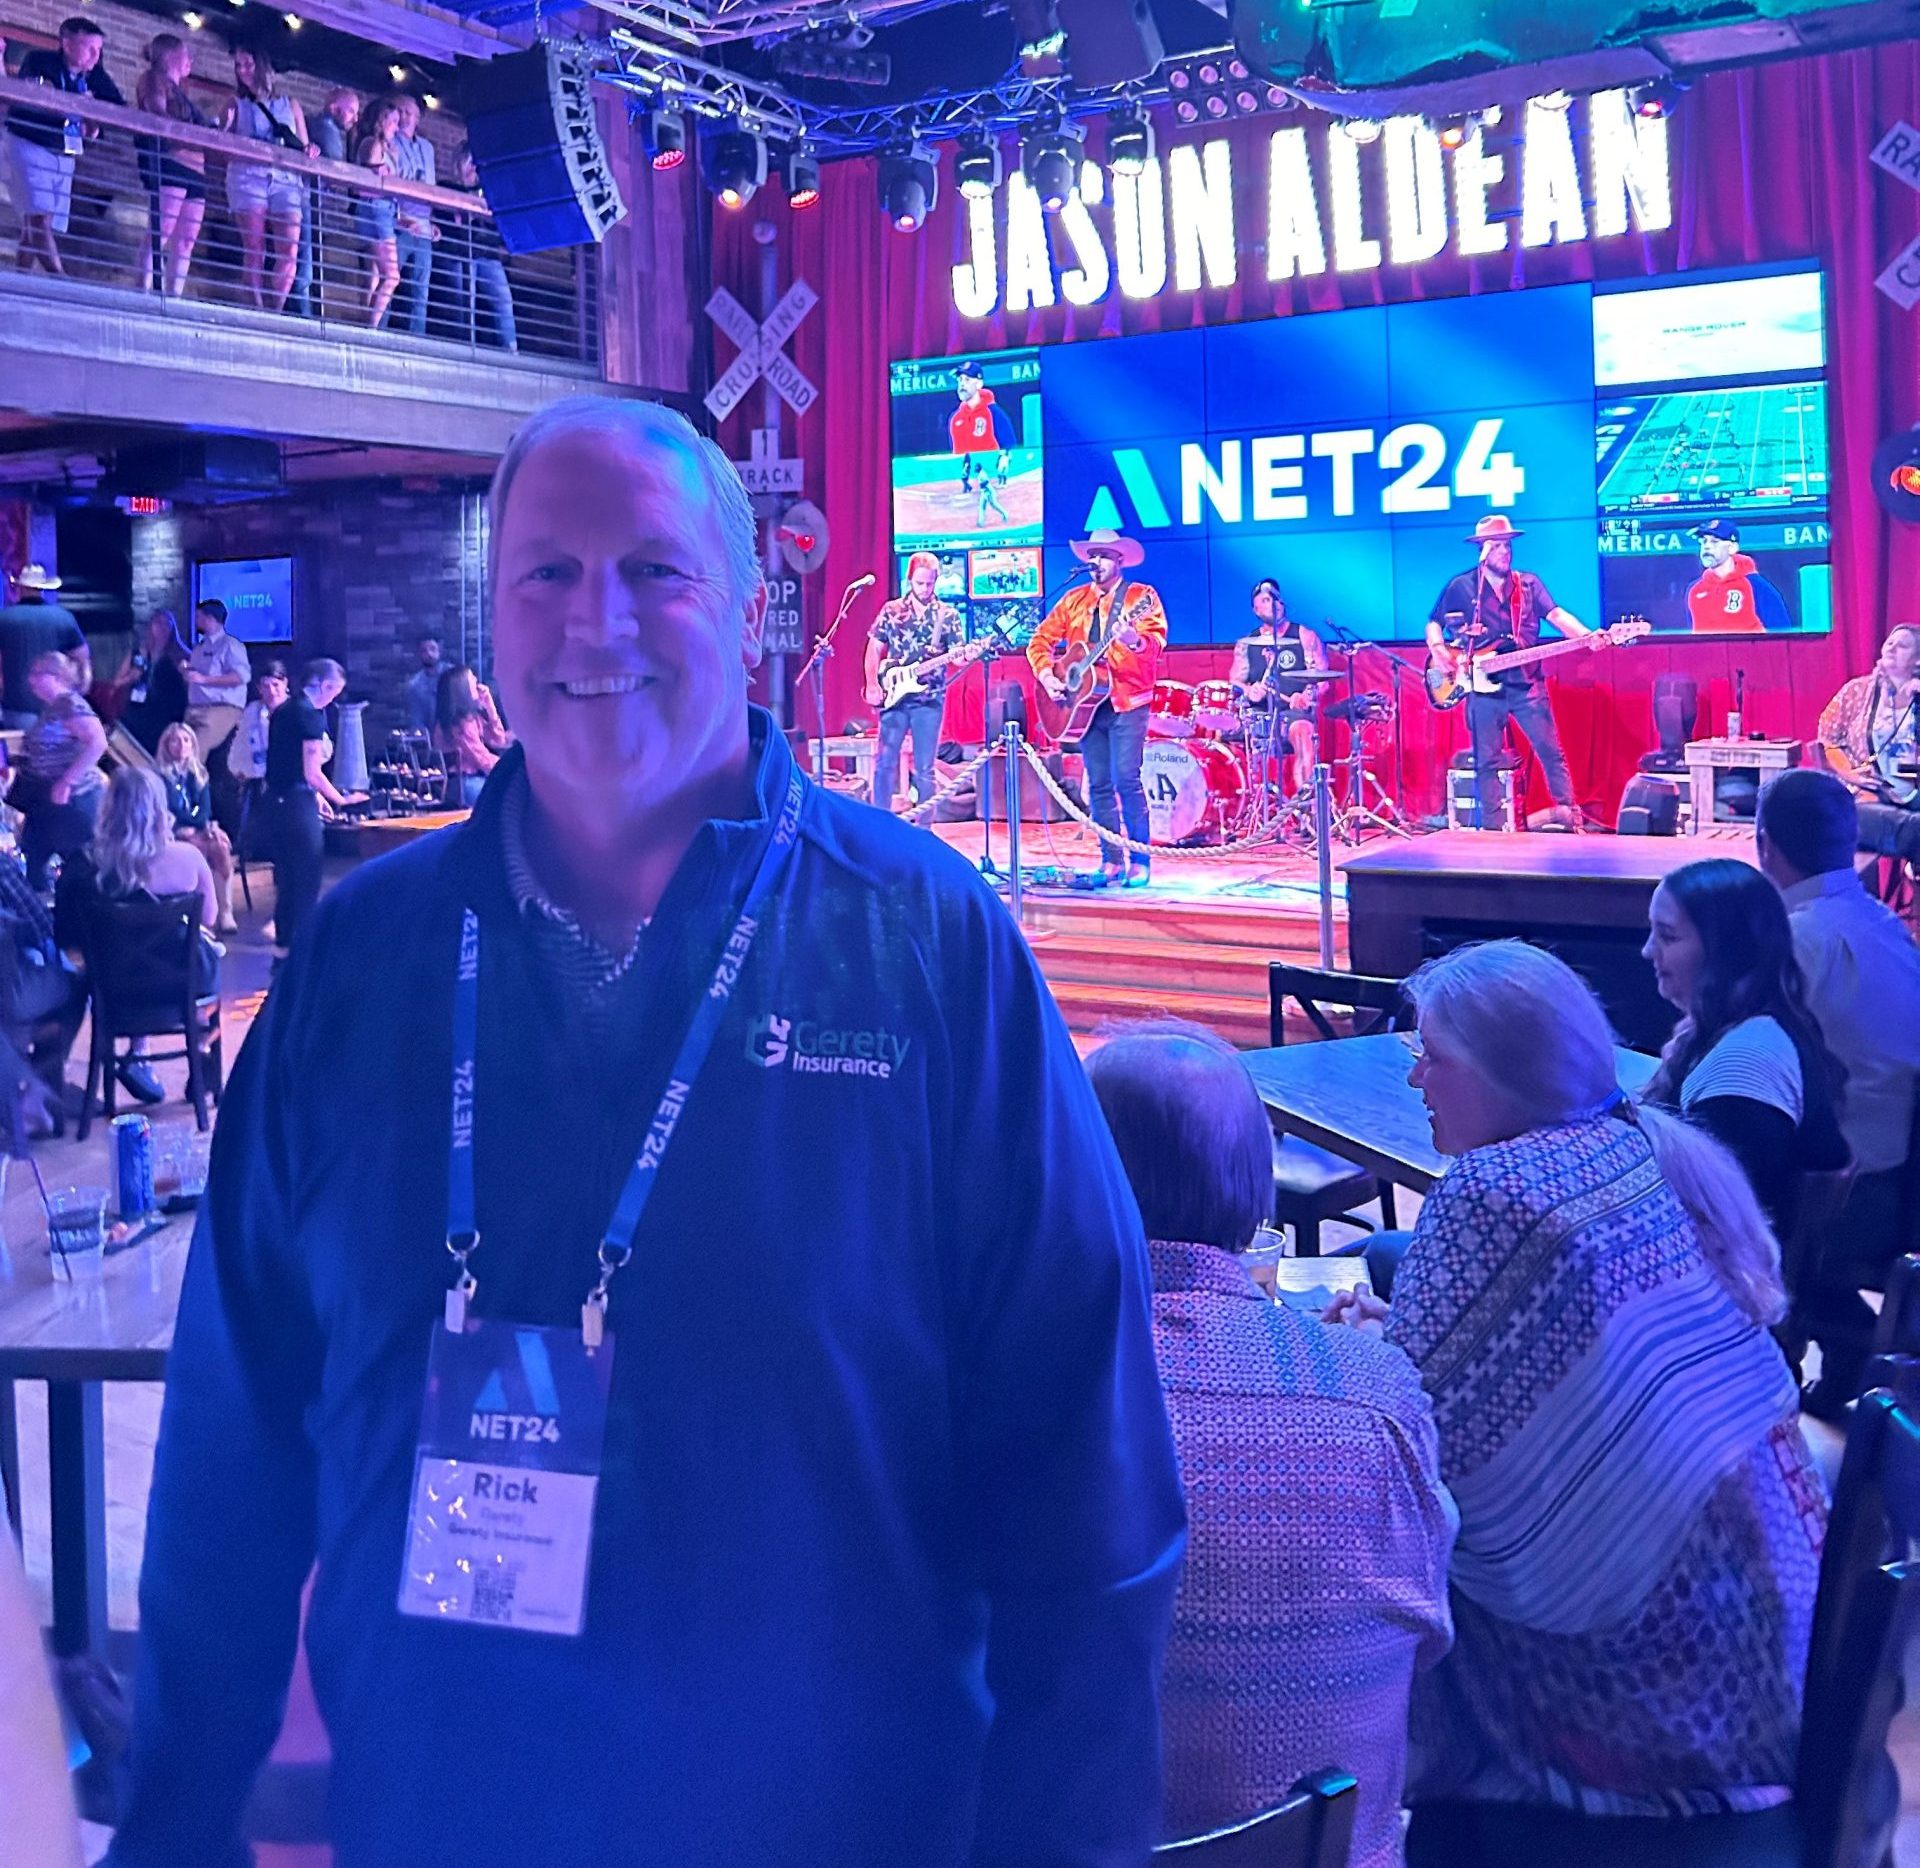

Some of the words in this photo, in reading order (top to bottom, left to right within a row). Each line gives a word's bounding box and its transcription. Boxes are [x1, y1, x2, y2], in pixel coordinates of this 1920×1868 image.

[951, 140, 1237, 317] JASON
[1267, 88, 1673, 282] ALDEAN
[767, 356, 811, 408] ROAD
[740, 467, 794, 484] RACK
[1181, 418, 1525, 525] NET24
[1597, 533, 1682, 553] MERICA
[233, 593, 273, 609] NET24
[767, 610, 799, 626] RED
[1153, 752, 1189, 764] Roland
[774, 777, 803, 845] NET24
[709, 914, 758, 999] NET24
[792, 1051, 892, 1079] Insurance
[795, 1020, 911, 1073] Gerety
[453, 1060, 474, 1148] NET24
[637, 1079, 690, 1170] NET24
[469, 1413, 561, 1444] NET24
[473, 1471, 538, 1504] Rick
